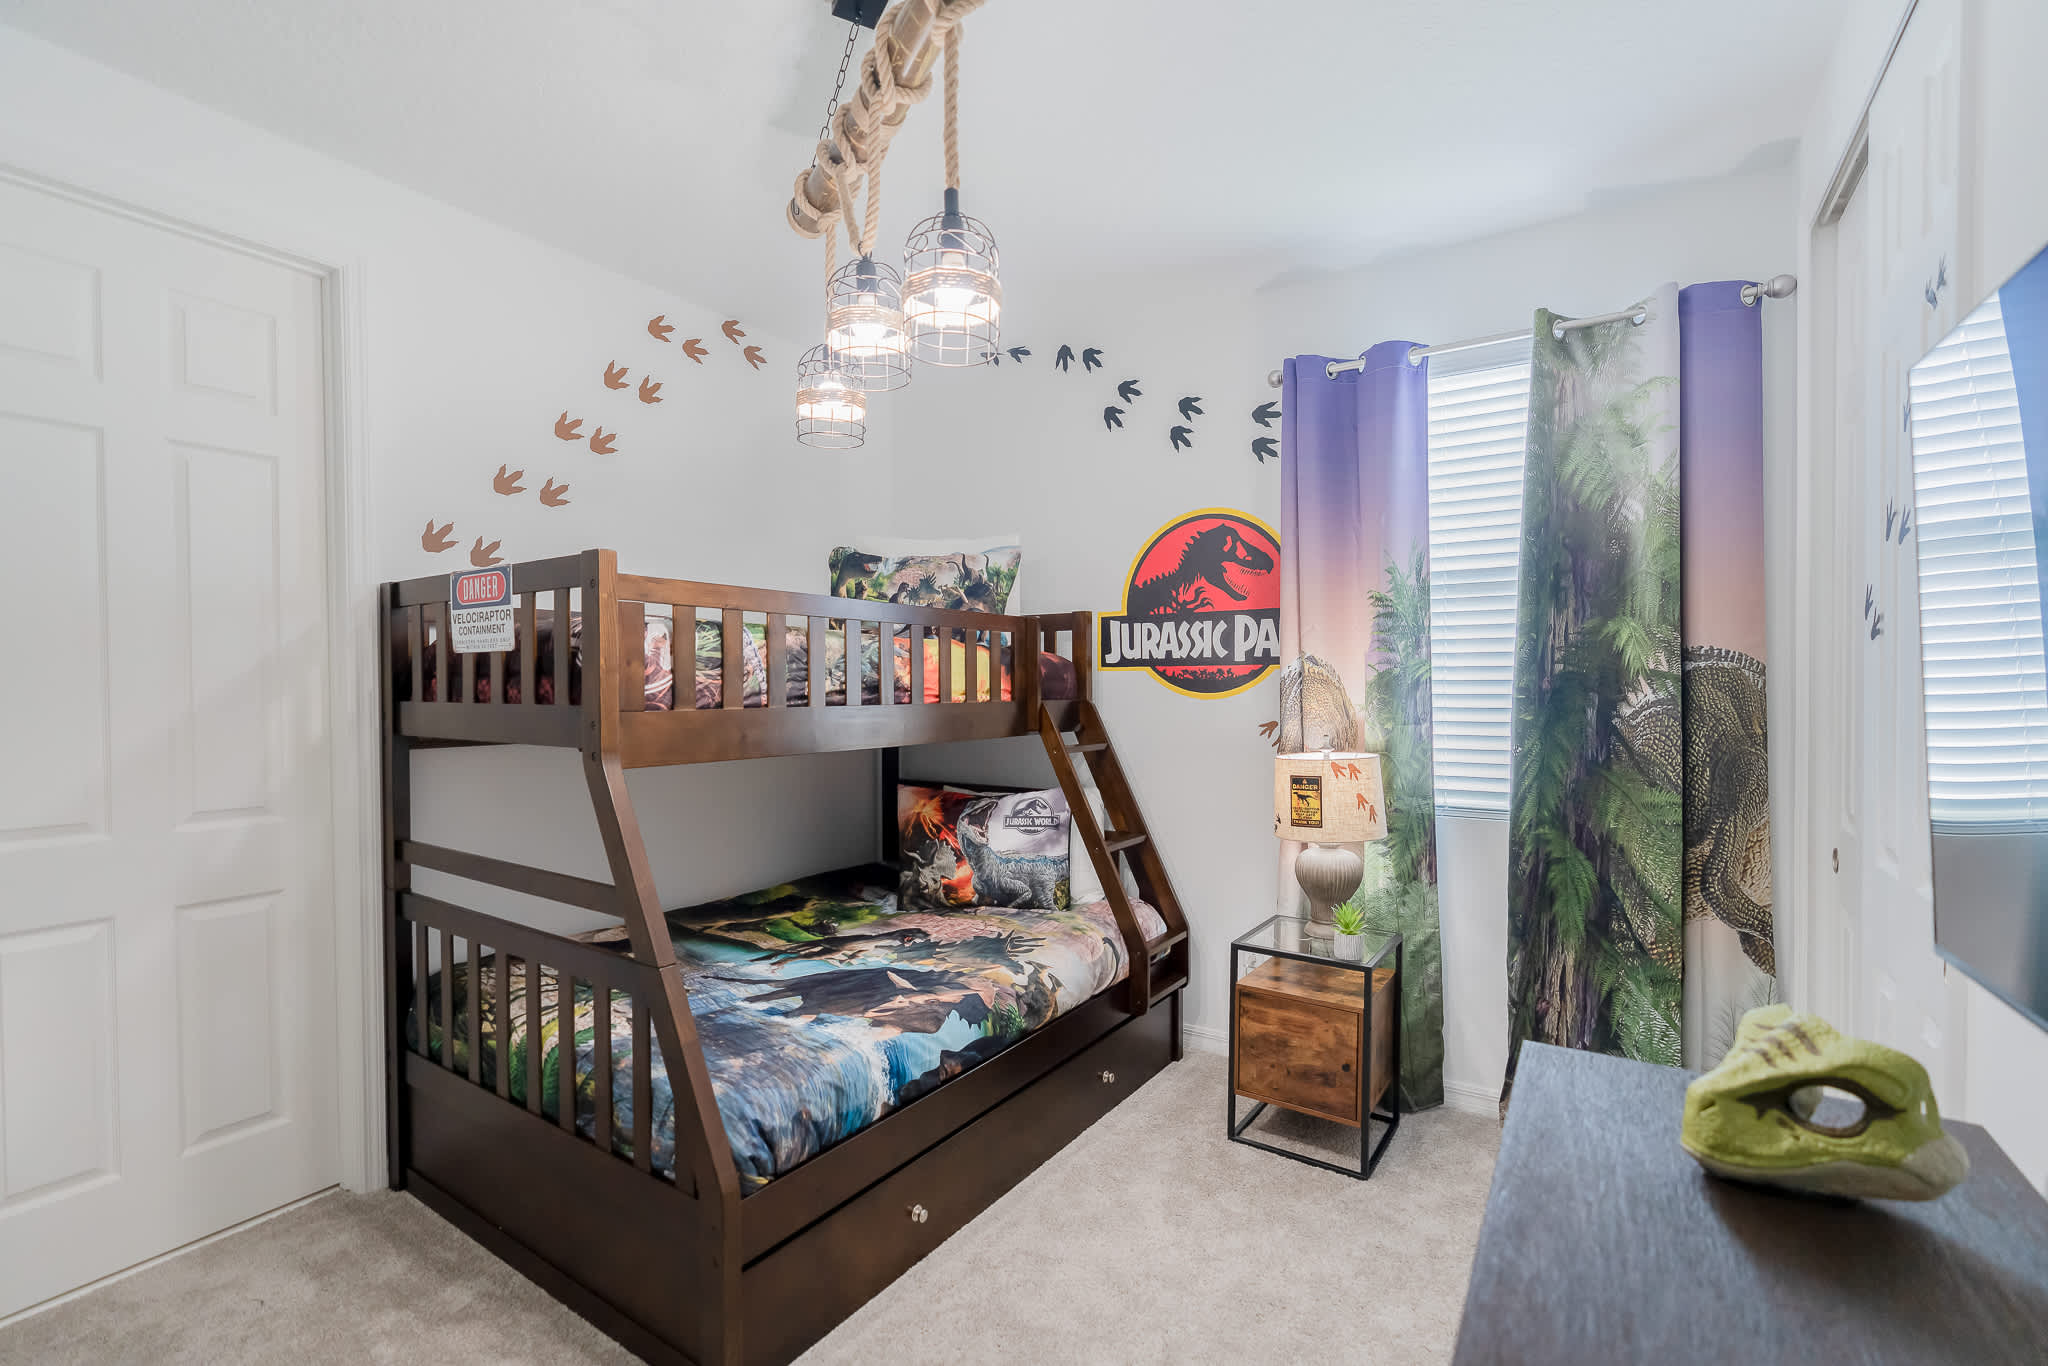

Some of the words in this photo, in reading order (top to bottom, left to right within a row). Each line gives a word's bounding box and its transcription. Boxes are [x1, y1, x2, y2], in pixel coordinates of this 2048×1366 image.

[463, 576, 498, 600] DANGER
[452, 609, 511, 624] VELOCIRAPTOR
[458, 624, 505, 636] CONTAINMENT
[1105, 619, 1229, 664] JURASSIC
[1234, 614, 1280, 662] PA
[1005, 817, 1032, 826] JURASSIC
[1034, 817, 1058, 826] WORLD
